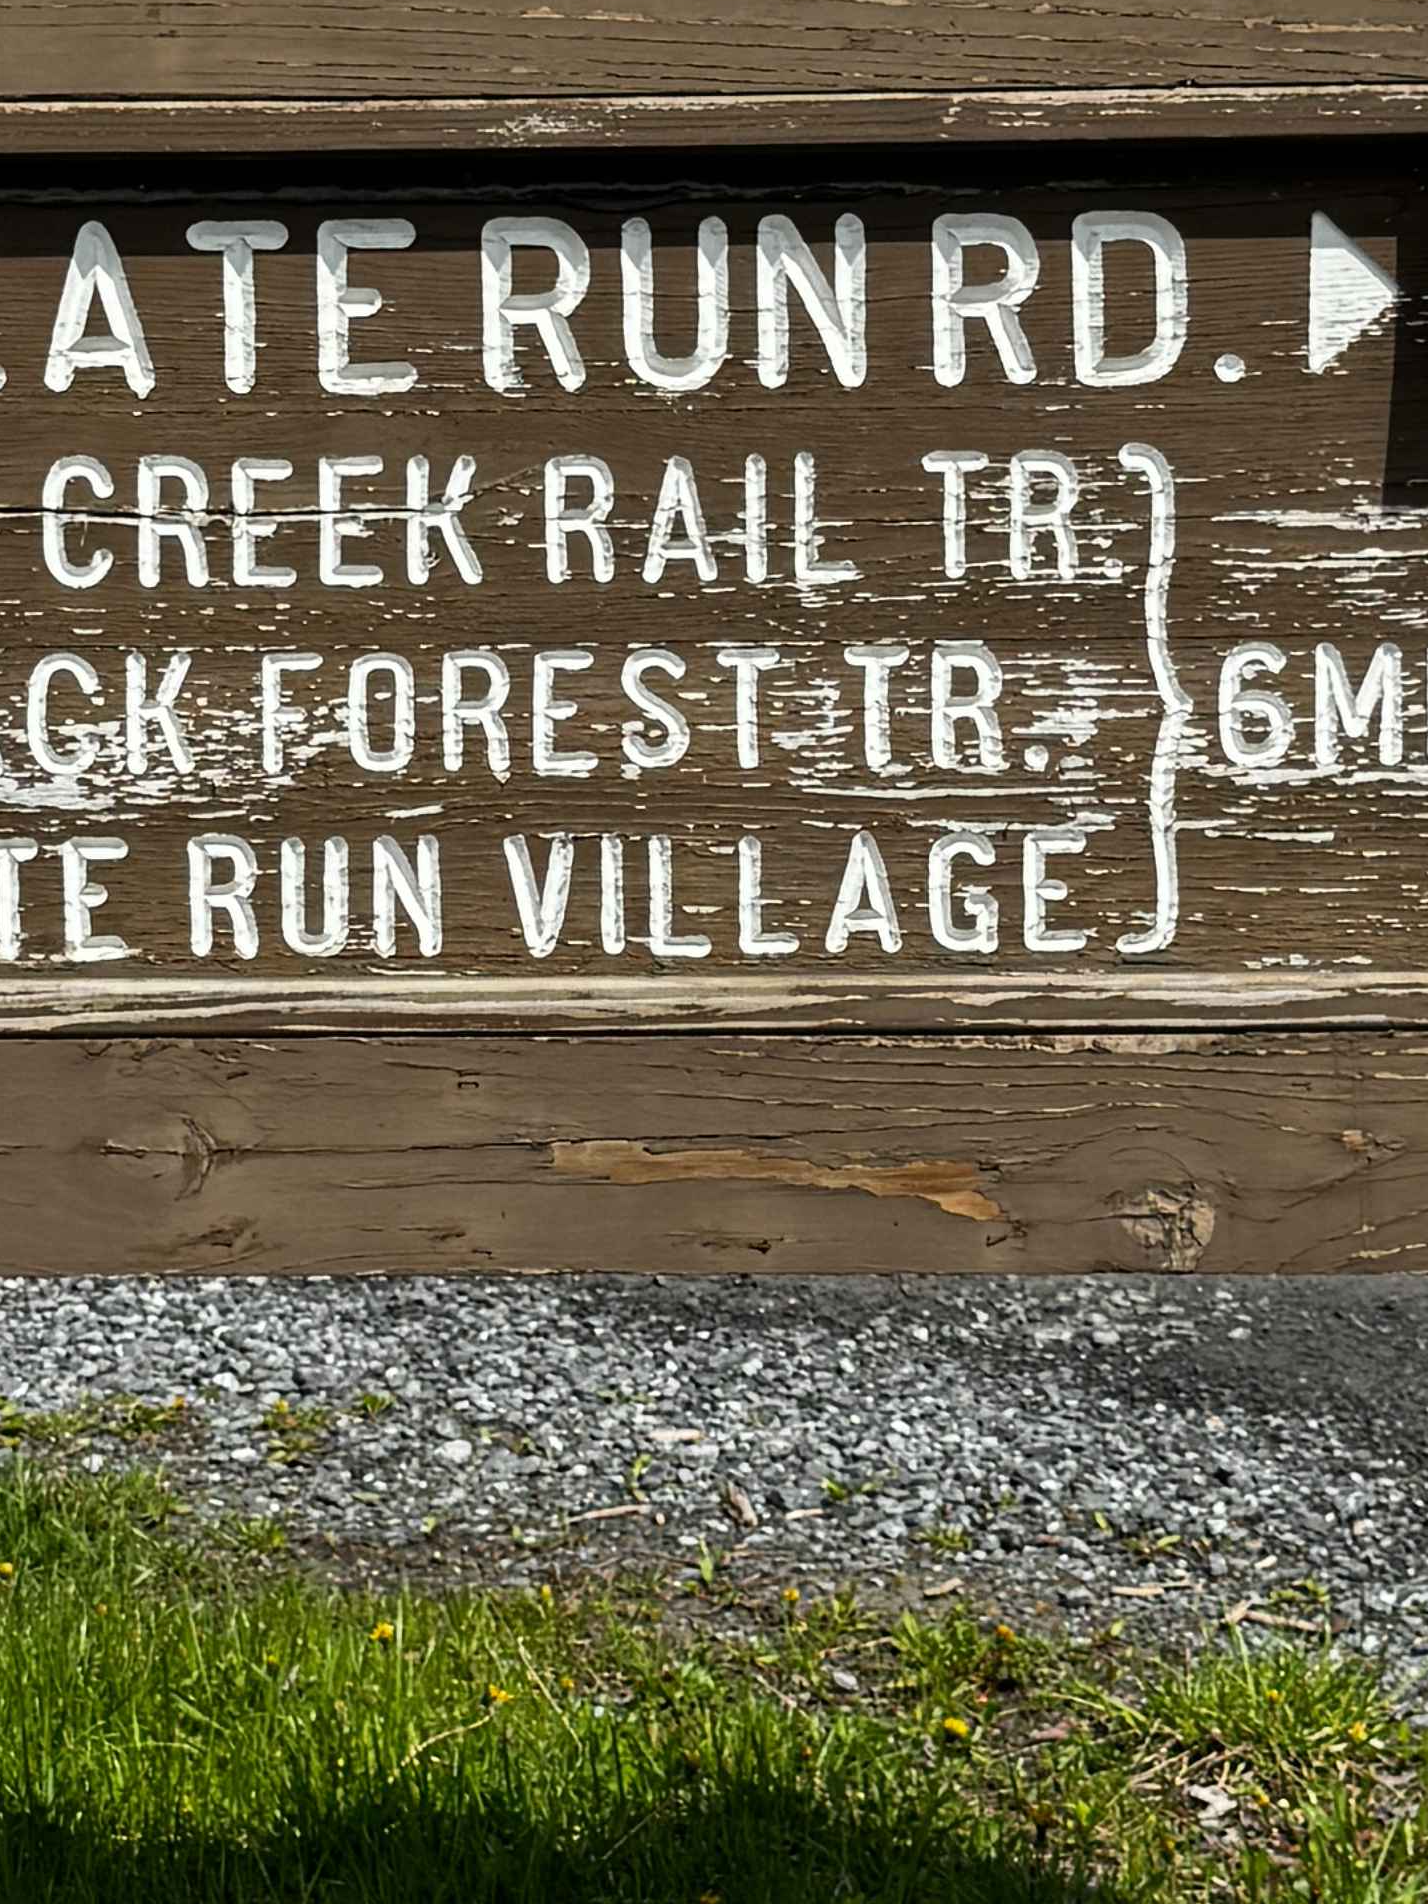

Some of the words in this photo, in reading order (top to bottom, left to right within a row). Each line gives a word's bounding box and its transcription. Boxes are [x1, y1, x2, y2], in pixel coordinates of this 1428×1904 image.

[480, 211, 868, 392] RUN
[930, 210, 1247, 388] RD.
[41, 453, 484, 590] CREEK
[543, 452, 860, 584] RAIL
[920, 447, 1124, 582] TR.
[259, 646, 781, 780] FOREST
[843, 643, 1051, 773] TR.
[186, 833, 442, 961] RUN
[502, 829, 1090, 960] VILLAGE
